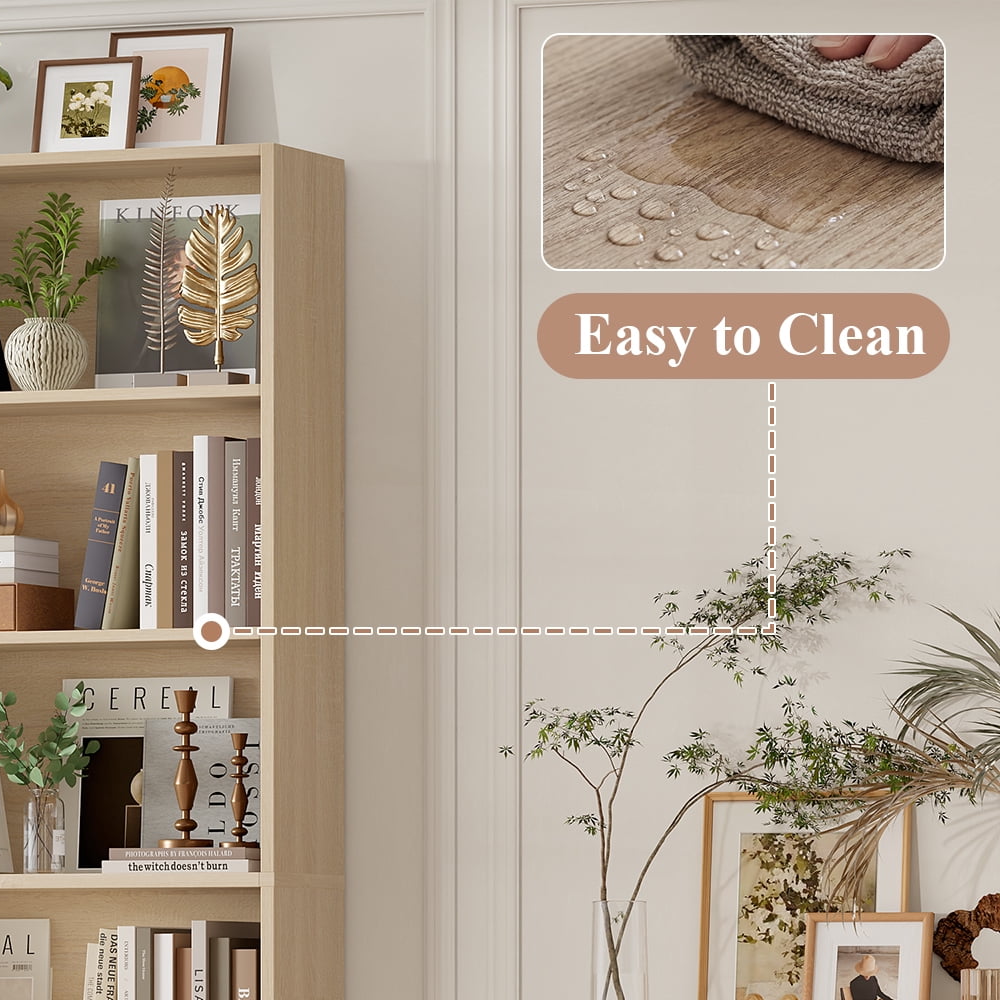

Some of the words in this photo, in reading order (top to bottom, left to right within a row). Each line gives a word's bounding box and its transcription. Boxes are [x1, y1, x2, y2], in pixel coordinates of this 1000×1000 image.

[101, 482, 117, 495] 41
[232, 458, 241, 505] Иммануил
[232, 508, 241, 531] Кант
[84, 577, 105, 587] George
[142, 563, 154, 608] Спартак
[231, 546, 241, 607] ТРАКТАТЫ
[90, 585, 107, 595] Bush
[82, 685, 221, 711] CEREL
[125, 850, 169, 858] PHOTOGRAPHS
[178, 850, 207, 859] FRANÇOIS
[208, 850, 233, 858] HALARD
[206, 863, 229, 872] burn
[99, 932, 107, 949] die
[109, 934, 118, 954] DAS
[97, 949, 105, 971] neue
[107, 957, 117, 982] NEUE
[95, 971, 103, 995] stadt
